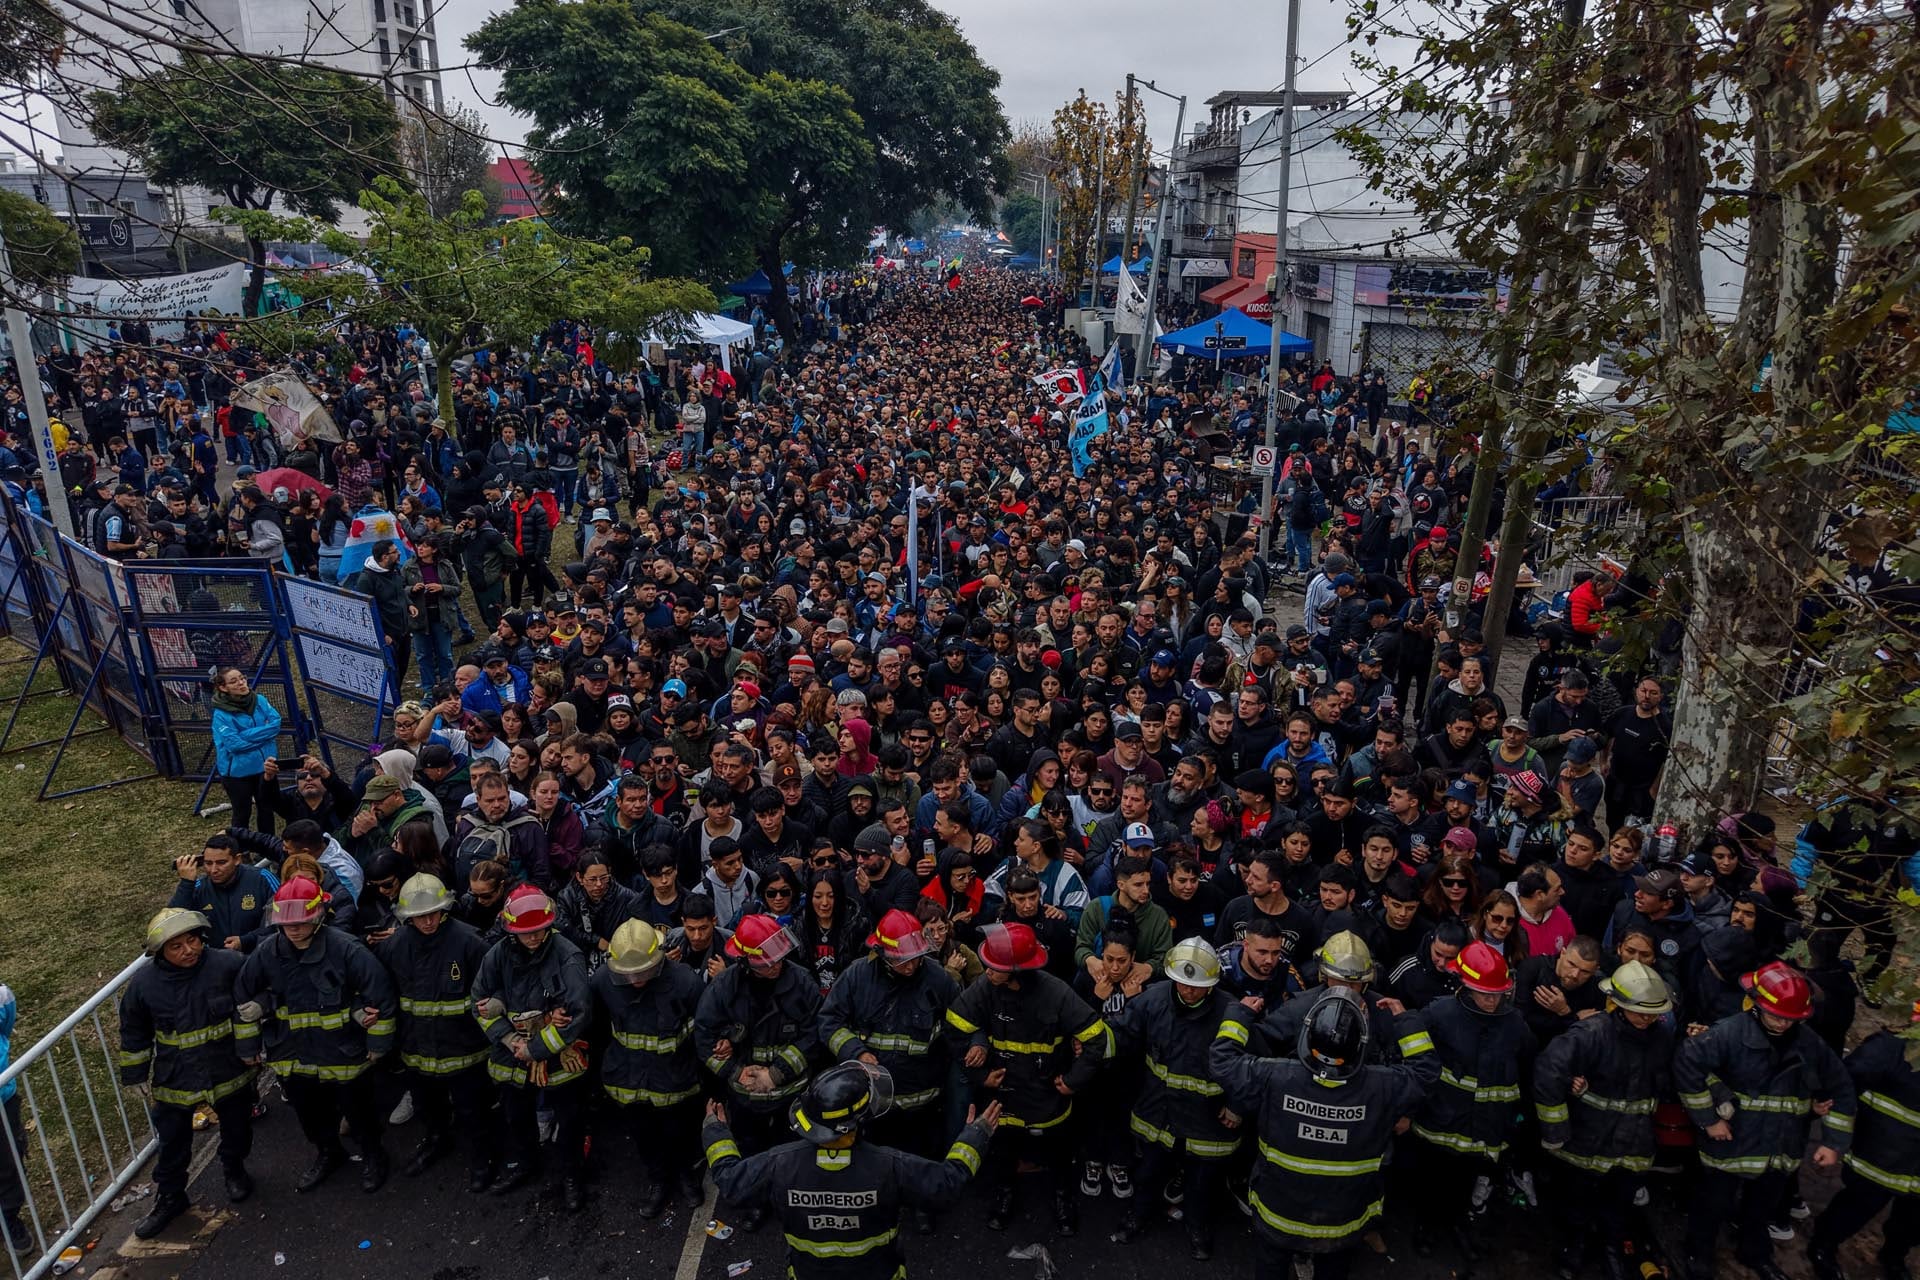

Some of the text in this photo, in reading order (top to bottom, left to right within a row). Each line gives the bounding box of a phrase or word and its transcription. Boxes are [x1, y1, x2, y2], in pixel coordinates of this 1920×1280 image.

[195, 270, 229, 284] tendido
[175, 282, 212, 297] servido
[41, 427, 57, 471] 4662
[1286, 1098, 1363, 1119] BOMBEROS
[1302, 1126, 1343, 1142] P.B.A.
[790, 1192, 875, 1207] BOMBEROS
[812, 1216, 856, 1228] P.B.A.
